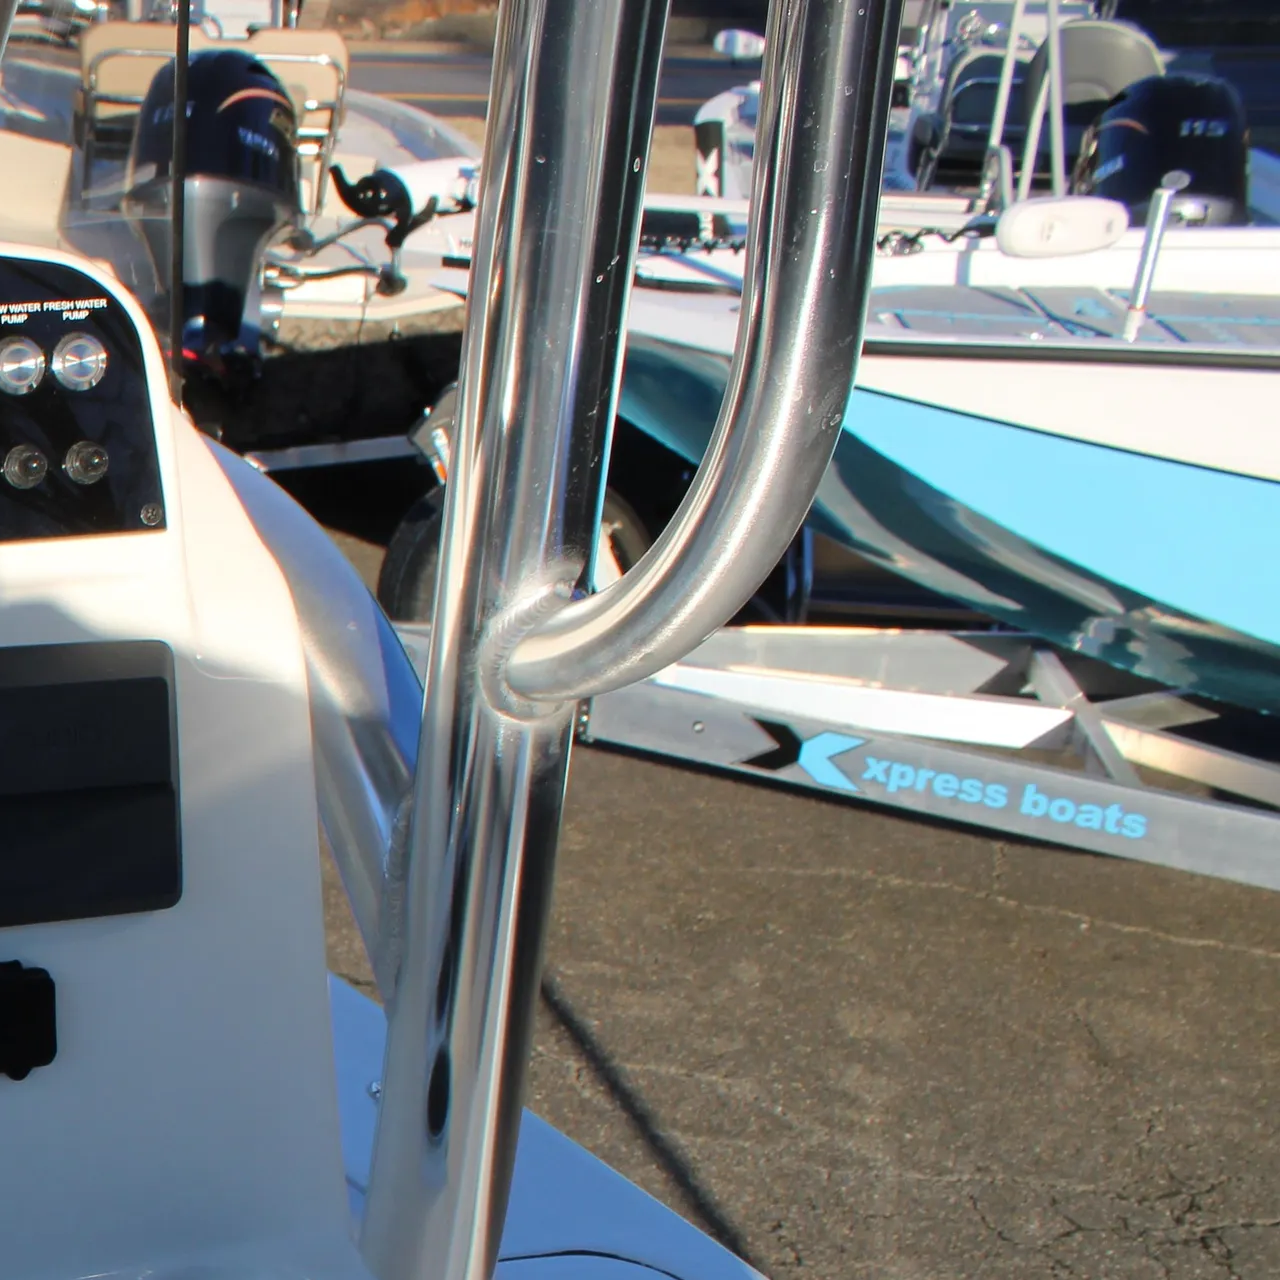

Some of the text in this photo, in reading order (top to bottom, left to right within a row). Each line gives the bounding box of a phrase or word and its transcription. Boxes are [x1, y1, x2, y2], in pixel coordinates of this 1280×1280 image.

[8, 302, 42, 313] WATER
[43, 298, 108, 311] FRESH WATER
[1, 314, 28, 324] PUMP
[62, 310, 90, 321] PUMP
[860, 755, 1149, 840] xpress boats
